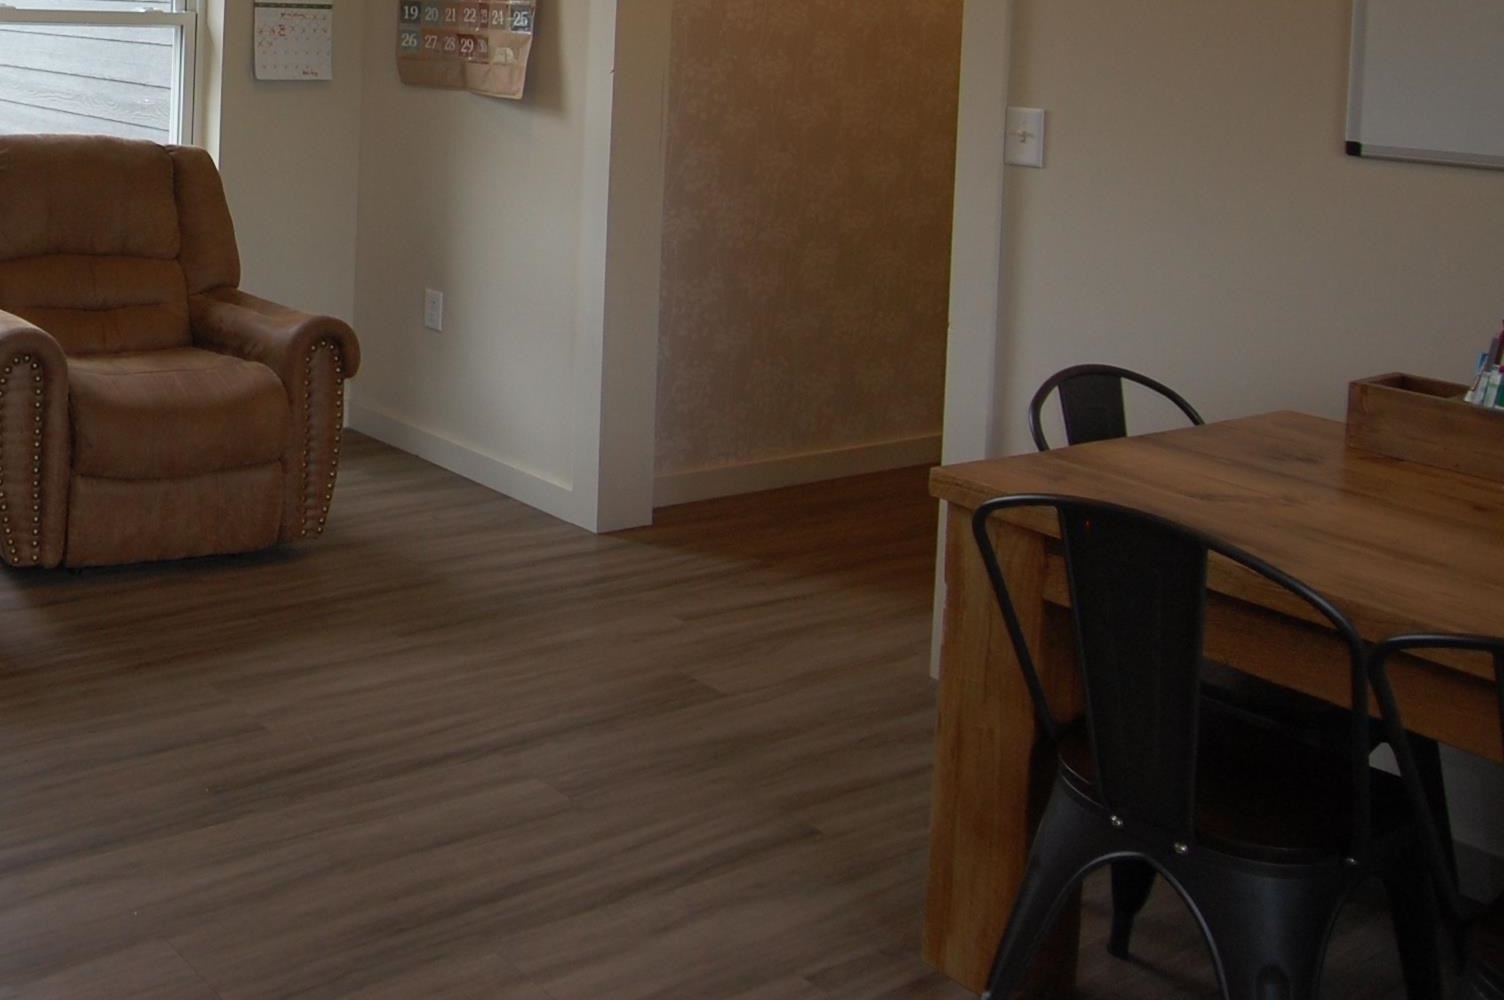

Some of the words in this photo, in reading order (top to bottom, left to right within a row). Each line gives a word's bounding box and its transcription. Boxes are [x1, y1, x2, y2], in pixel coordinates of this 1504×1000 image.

[403, 5, 419, 20] 19
[424, 6, 439, 21] 20
[444, 7, 456, 22] 21
[462, 7, 477, 23] 22
[491, 9, 504, 25] 24
[400, 33, 417, 48] 26
[423, 35, 438, 49] 27
[444, 36, 456, 51] 28
[460, 38, 474, 53] 29
